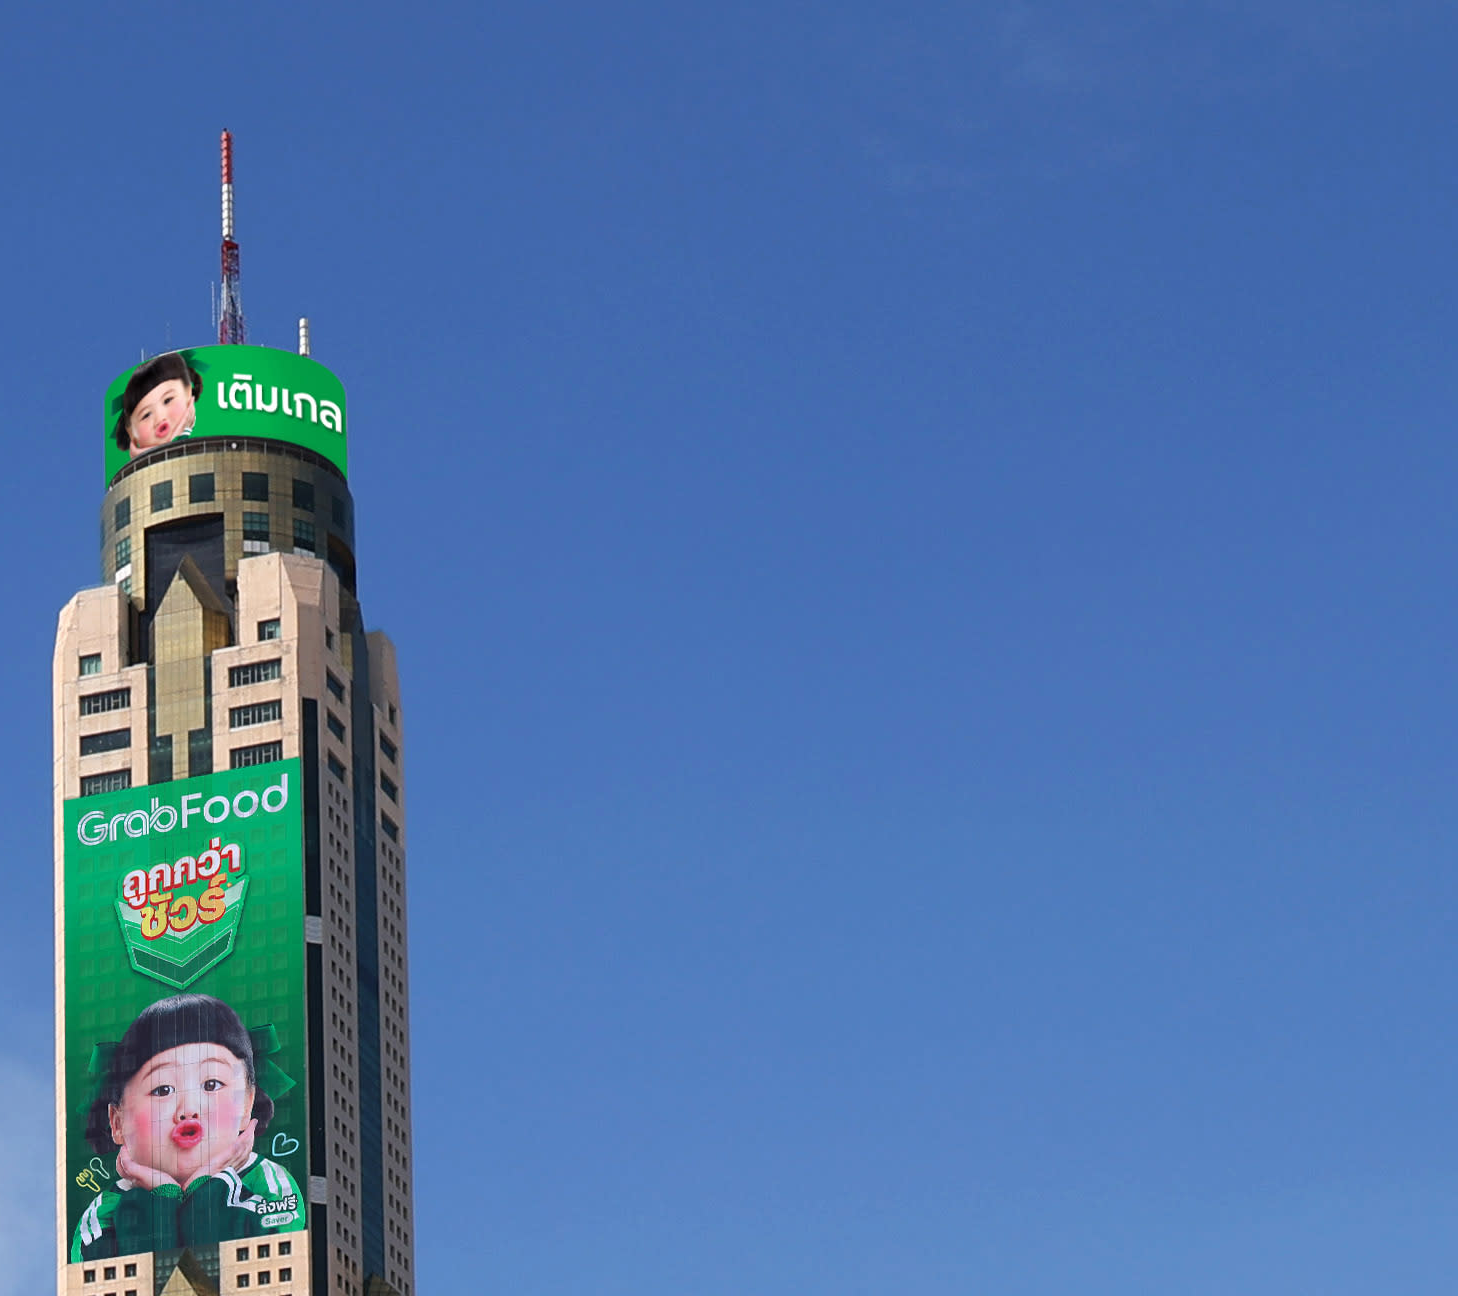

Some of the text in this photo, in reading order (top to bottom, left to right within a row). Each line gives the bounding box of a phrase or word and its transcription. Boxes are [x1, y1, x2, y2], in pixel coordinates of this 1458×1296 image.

[77, 773, 289, 847] GrabFood
[140, 873, 228, 941] ชัวร์
[257, 1195, 298, 1215] ส่งฟรี
[265, 1215, 289, 1225] Saver
